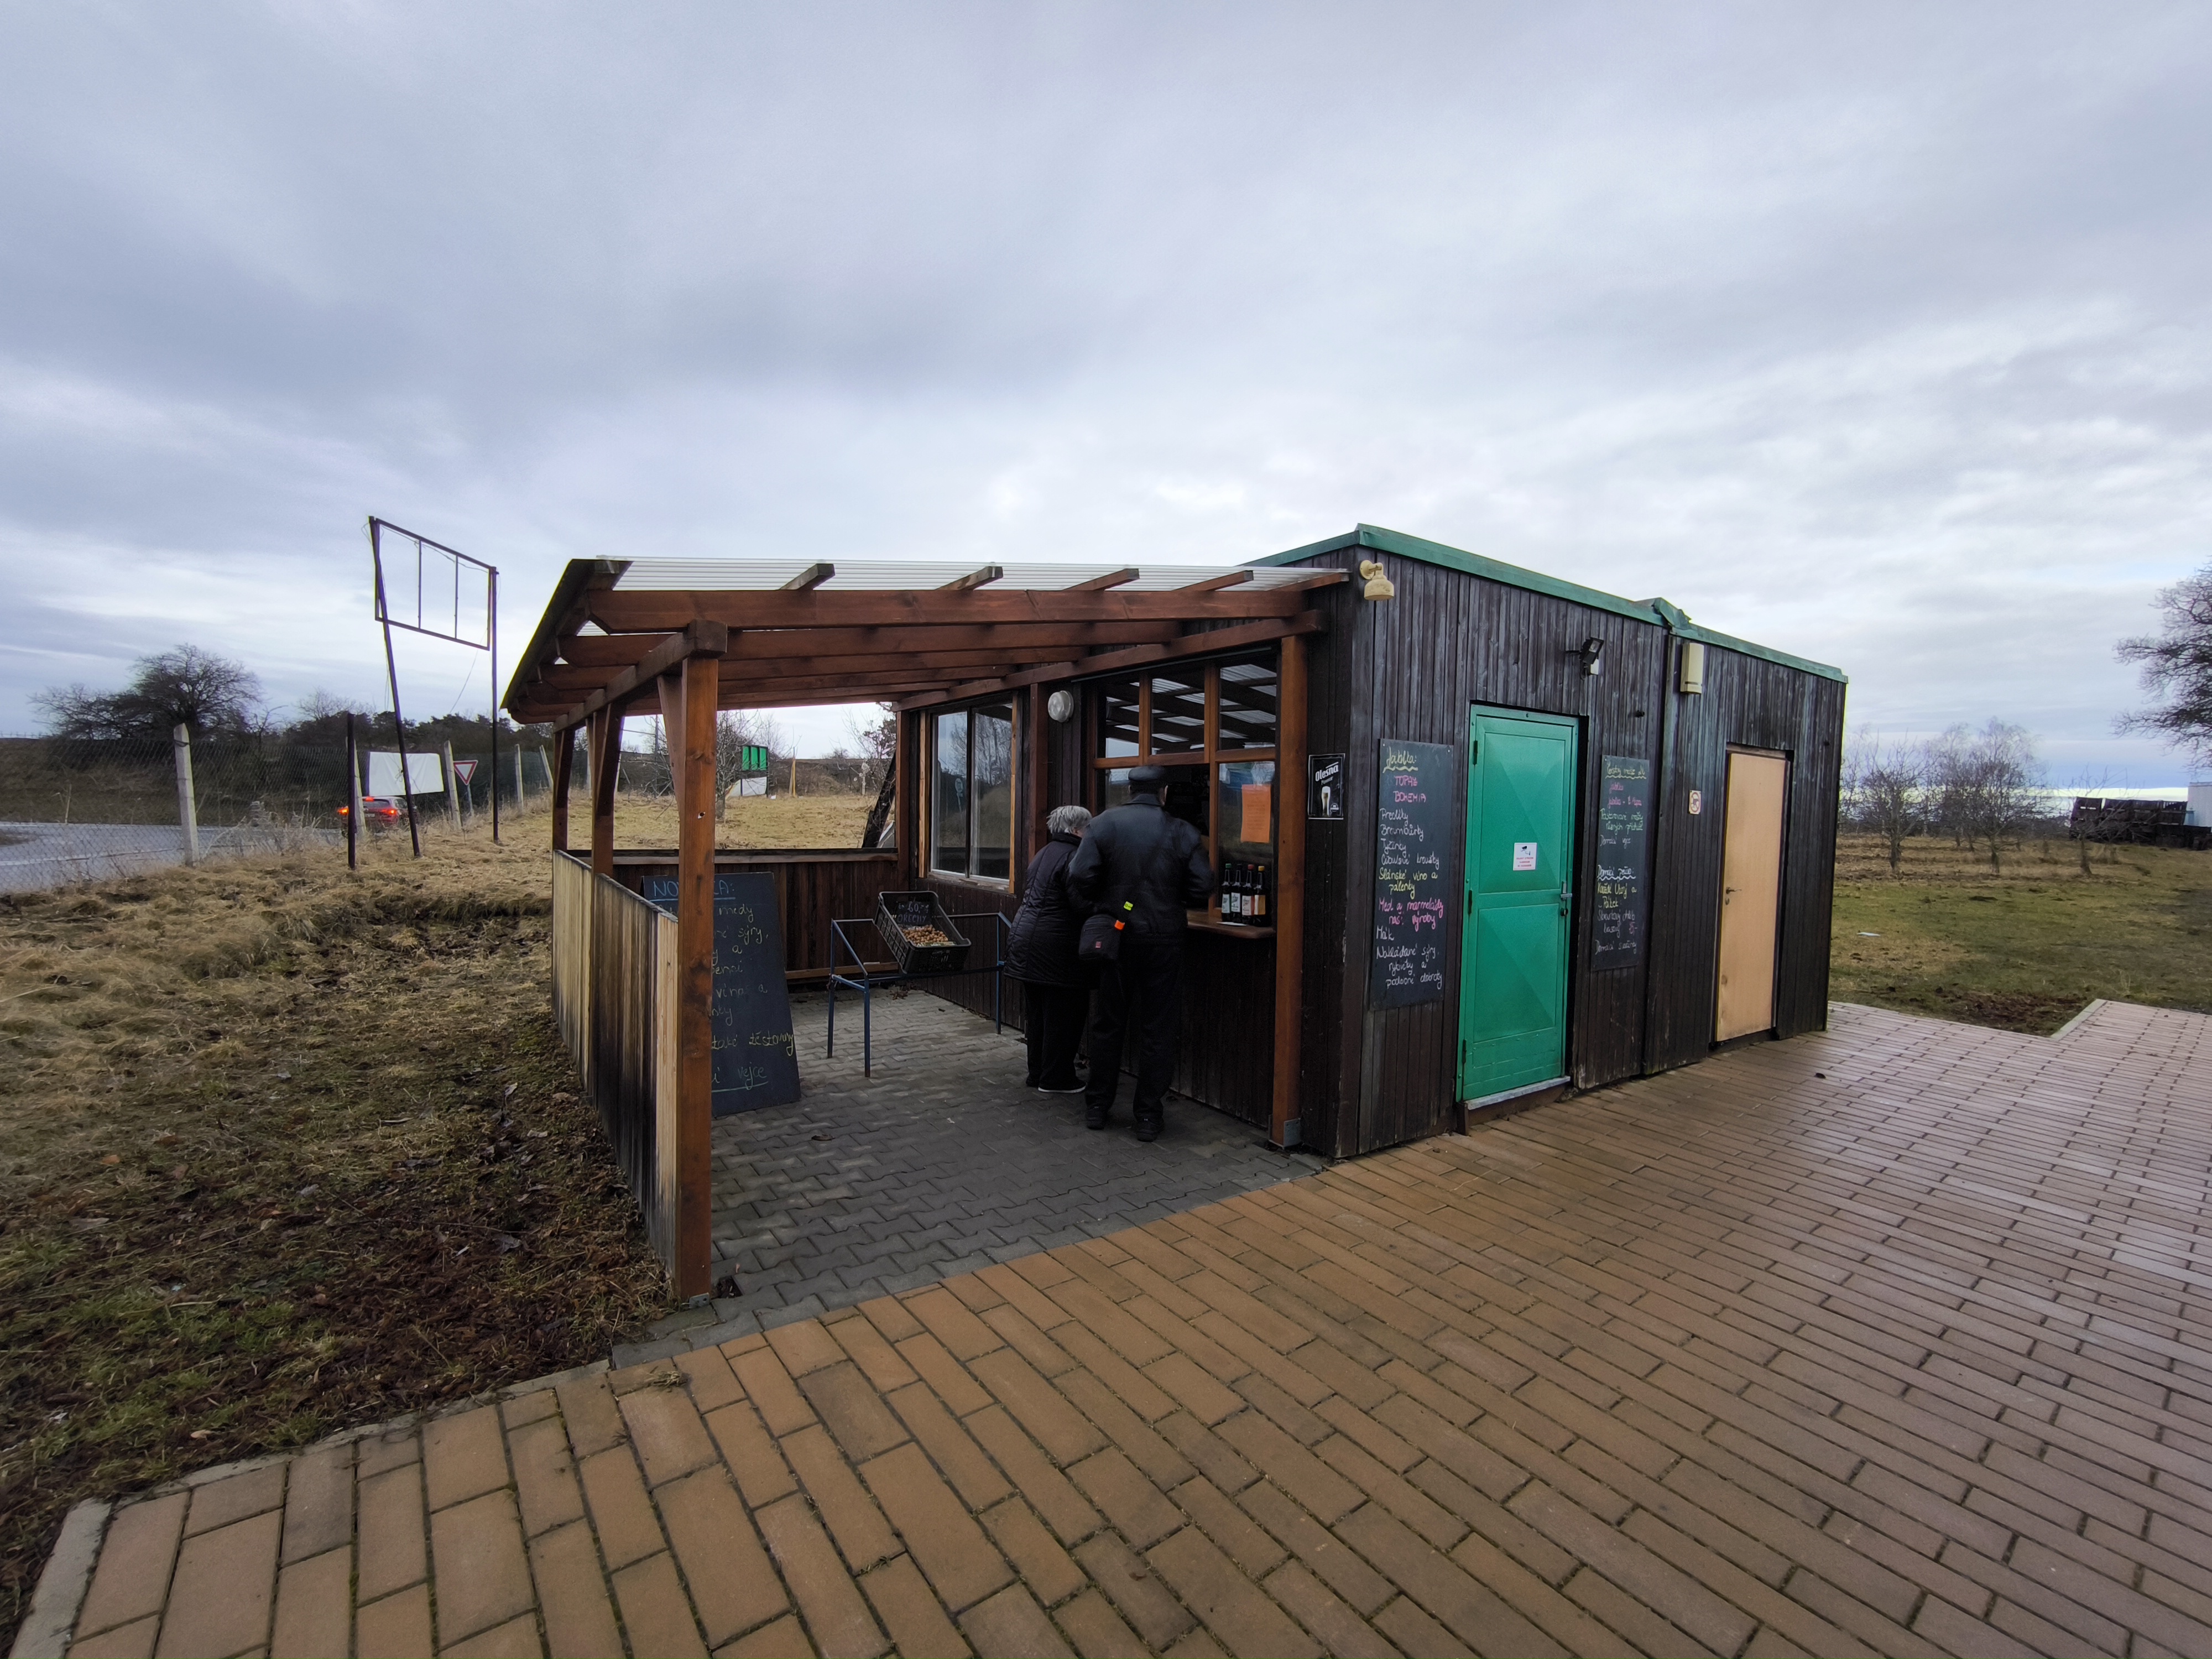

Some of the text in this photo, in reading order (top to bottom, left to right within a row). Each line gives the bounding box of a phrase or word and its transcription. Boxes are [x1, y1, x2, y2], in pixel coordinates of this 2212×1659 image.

[1393, 791, 1426, 802] BOHEMIA
[1379, 867, 1407, 880] Slánské
[1413, 870, 1427, 881] víno
[719, 904, 754, 923] medy
[1376, 925, 1395, 941] Mák
[732, 945, 743, 954] a
[1376, 943, 1417, 959] Nakládané
[758, 984, 768, 993] a
[738, 1061, 768, 1090] vejce
